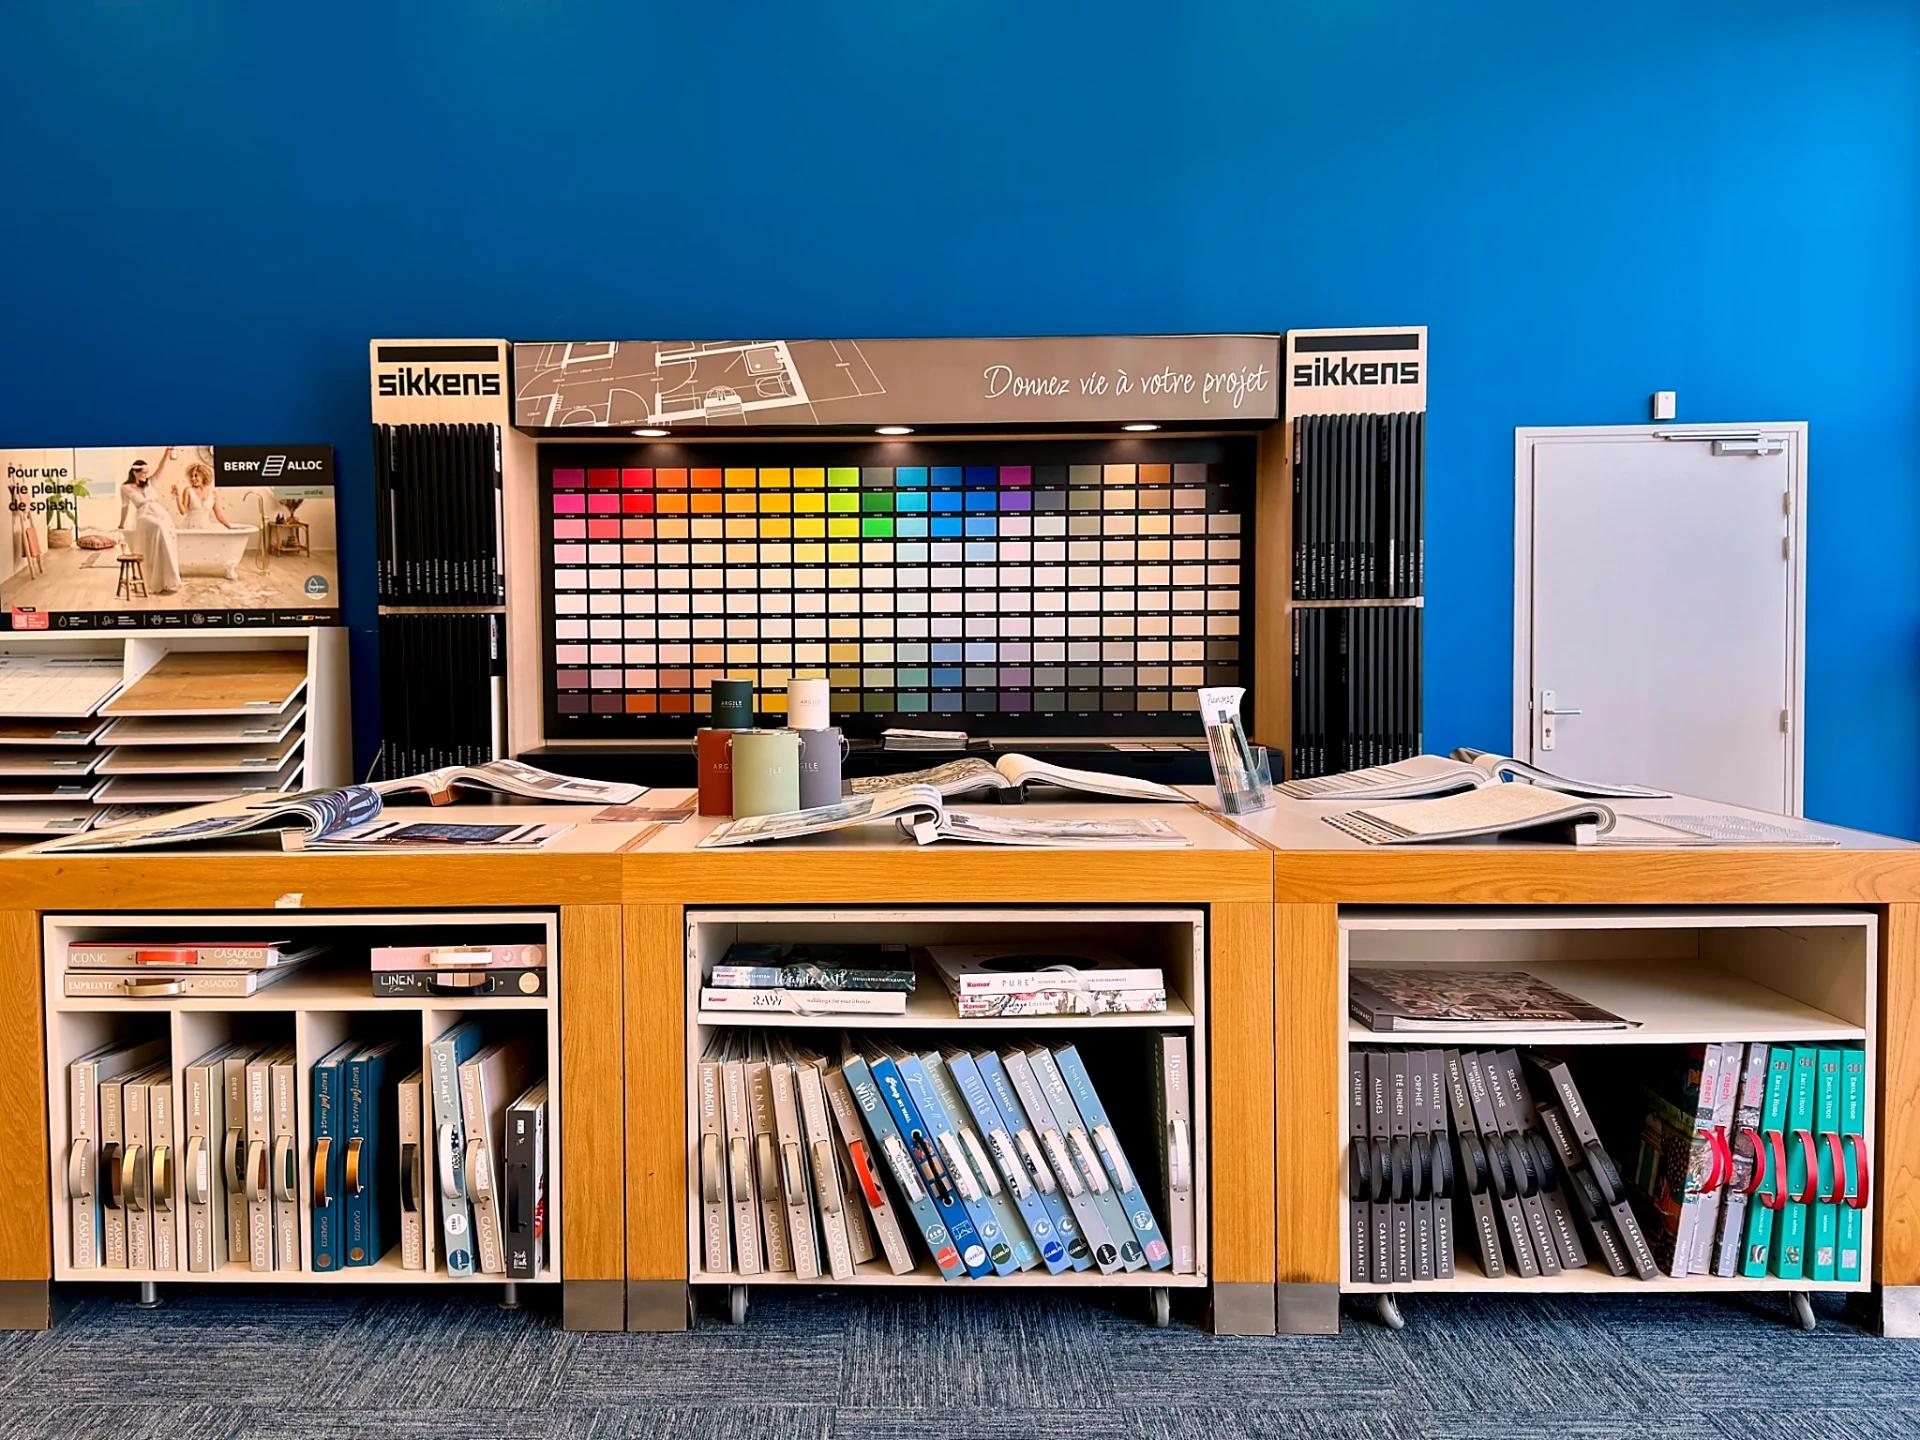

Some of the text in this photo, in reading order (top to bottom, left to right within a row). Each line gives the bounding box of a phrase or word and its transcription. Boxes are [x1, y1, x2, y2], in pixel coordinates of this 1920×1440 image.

[379, 368, 500, 398] sikkens
[984, 364, 1270, 408] Donnez vie à votre projet
[1294, 357, 1419, 387] sikkens
[8, 466, 67, 478] Pour une
[224, 460, 322, 471] BERRY ALLOC
[8, 483, 74, 498] vie pleine
[8, 499, 77, 514] de splash.
[71, 953, 107, 962] ICONIC
[214, 950, 262, 959] CASADECO
[199, 980, 238, 988] CASADECO
[381, 974, 414, 985] LINEN
[1002, 978, 1029, 987] PURE
[753, 995, 783, 1005] RAW
[438, 1053, 450, 1106] OUR PLANET
[804, 1076, 814, 1101] FLOWER
[926, 1060, 945, 1090] Green
[1017, 1064, 1041, 1112] Nos gravures
[1041, 1056, 1063, 1093] FLOWER
[1170, 1054, 1180, 1091] Hygge
[1414, 1075, 1423, 1107] ORPHÉE
[1449, 1059, 1464, 1108] TERRA ROSSA
[1472, 1061, 1484, 1096] PRINTEMPS
[1488, 1064, 1506, 1108] KARABANE
[1507, 1068, 1520, 1091] SELECT
[1703, 1075, 1712, 1103] rasch
[1722, 1072, 1732, 1100] rasch
[252, 1071, 262, 1112] RIVERSIDE
[704, 1067, 715, 1117] NICARAGUA
[729, 1070, 739, 1123] Méditerranée
[753, 1068, 765, 1120] VIENNE
[832, 1092, 845, 1118] SIXTIES
[839, 1088, 852, 1116] MILANO
[856, 1082, 876, 1112] WILD
[964, 1076, 990, 1115] OUTLINES
[992, 1071, 1014, 1113] Elegance
[1375, 1078, 1383, 1114] ALLIAGES
[1432, 1073, 1441, 1110] MANILLE
[1561, 1083, 1581, 1118] AVENTURA
[106, 1088, 116, 1134] LEATHERS
[900, 1106, 911, 1123] WALL
[1550, 1113, 1570, 1150] PANORAMAS
[79, 1212, 90, 1264] CASADECO
[255, 1214, 265, 1267] CASADECO
[481, 1216, 495, 1269] CASADECO
[708, 1216, 721, 1268] CASADECO
[742, 1215, 753, 1267] CASADECO
[769, 1215, 783, 1267] CASADECO
[796, 1219, 810, 1272] CASADECO
[830, 1220, 846, 1273] CASADECO
[853, 1216, 864, 1251] CASADECO
[888, 1230, 902, 1264] CASADECO
[1379, 1222, 1387, 1279] CASAMANCE
[1420, 1219, 1429, 1276] CASAMANCE
[1439, 1217, 1448, 1273] CASAMANCE
[1482, 1215, 1499, 1272] CASAMANCE
[1512, 1215, 1532, 1271] CASAMANCE
[1533, 1213, 1555, 1269] CASAMANCE
[1555, 1209, 1577, 1264] CASAMANCE
[1603, 1230, 1624, 1271] CASAMANCE
[1625, 1218, 1652, 1271] CASAMANCE
